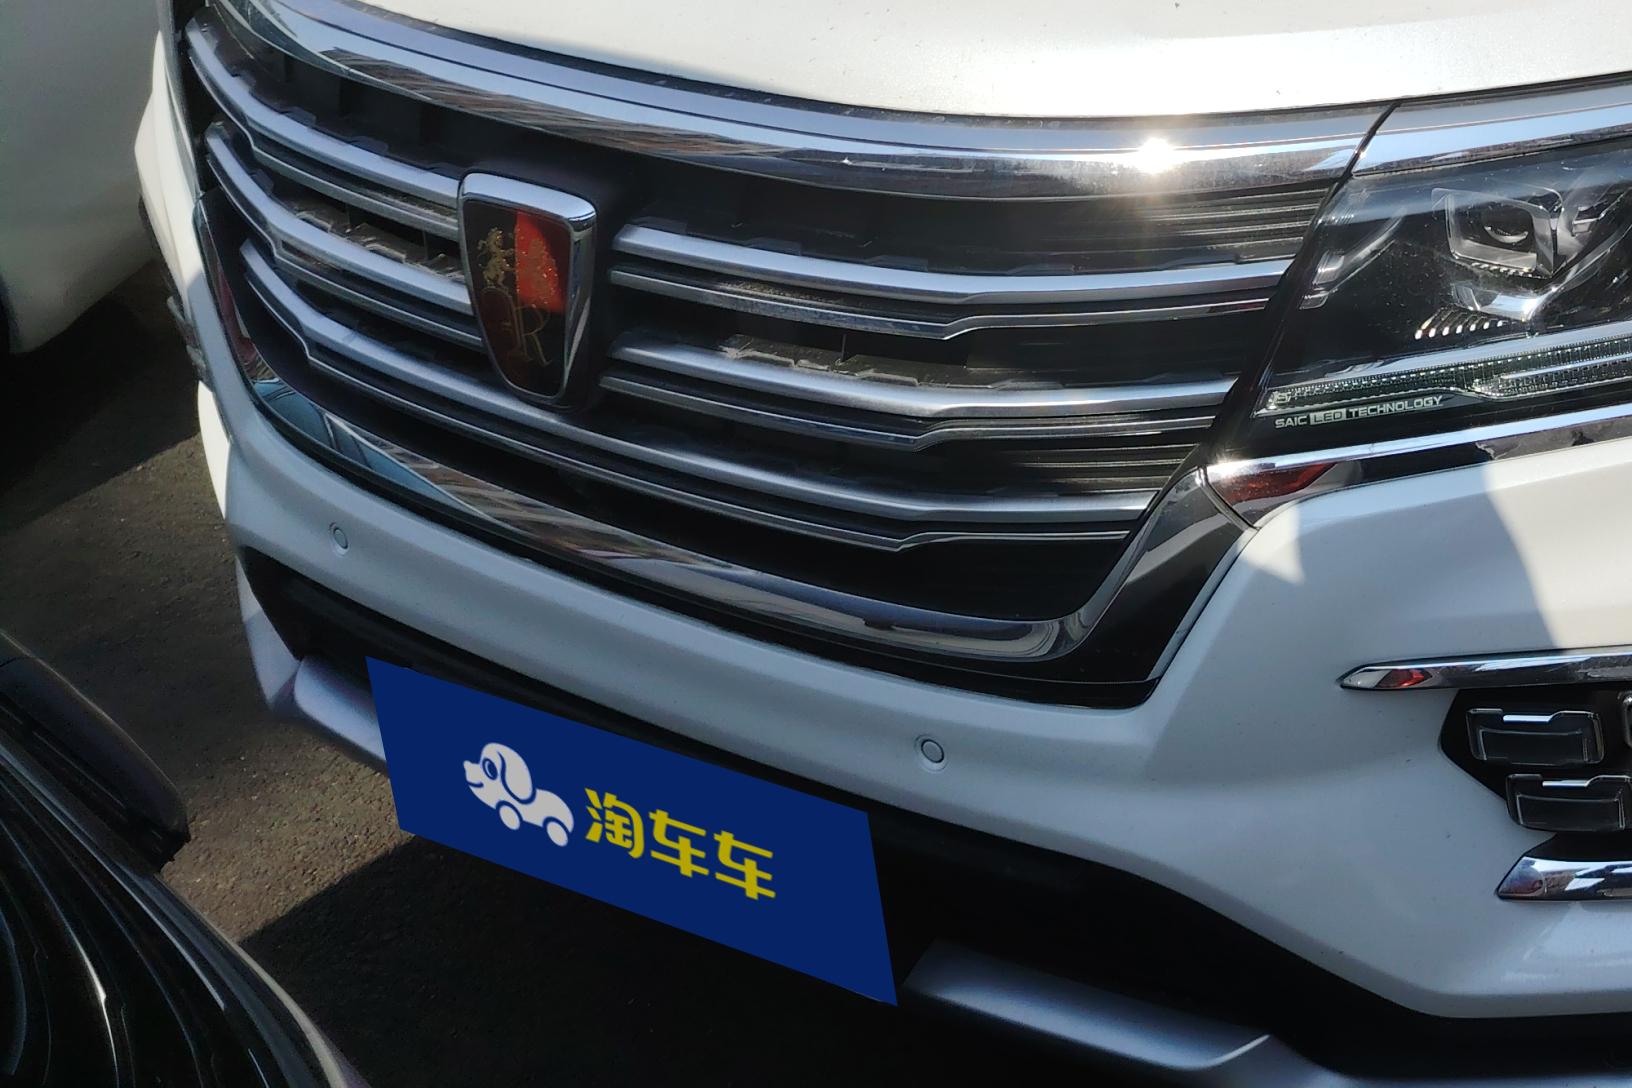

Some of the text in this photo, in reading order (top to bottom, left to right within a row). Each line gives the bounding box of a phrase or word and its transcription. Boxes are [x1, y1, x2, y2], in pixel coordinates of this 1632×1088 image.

[1274, 395, 1444, 429] SAIC LED TECHNOLOGY
